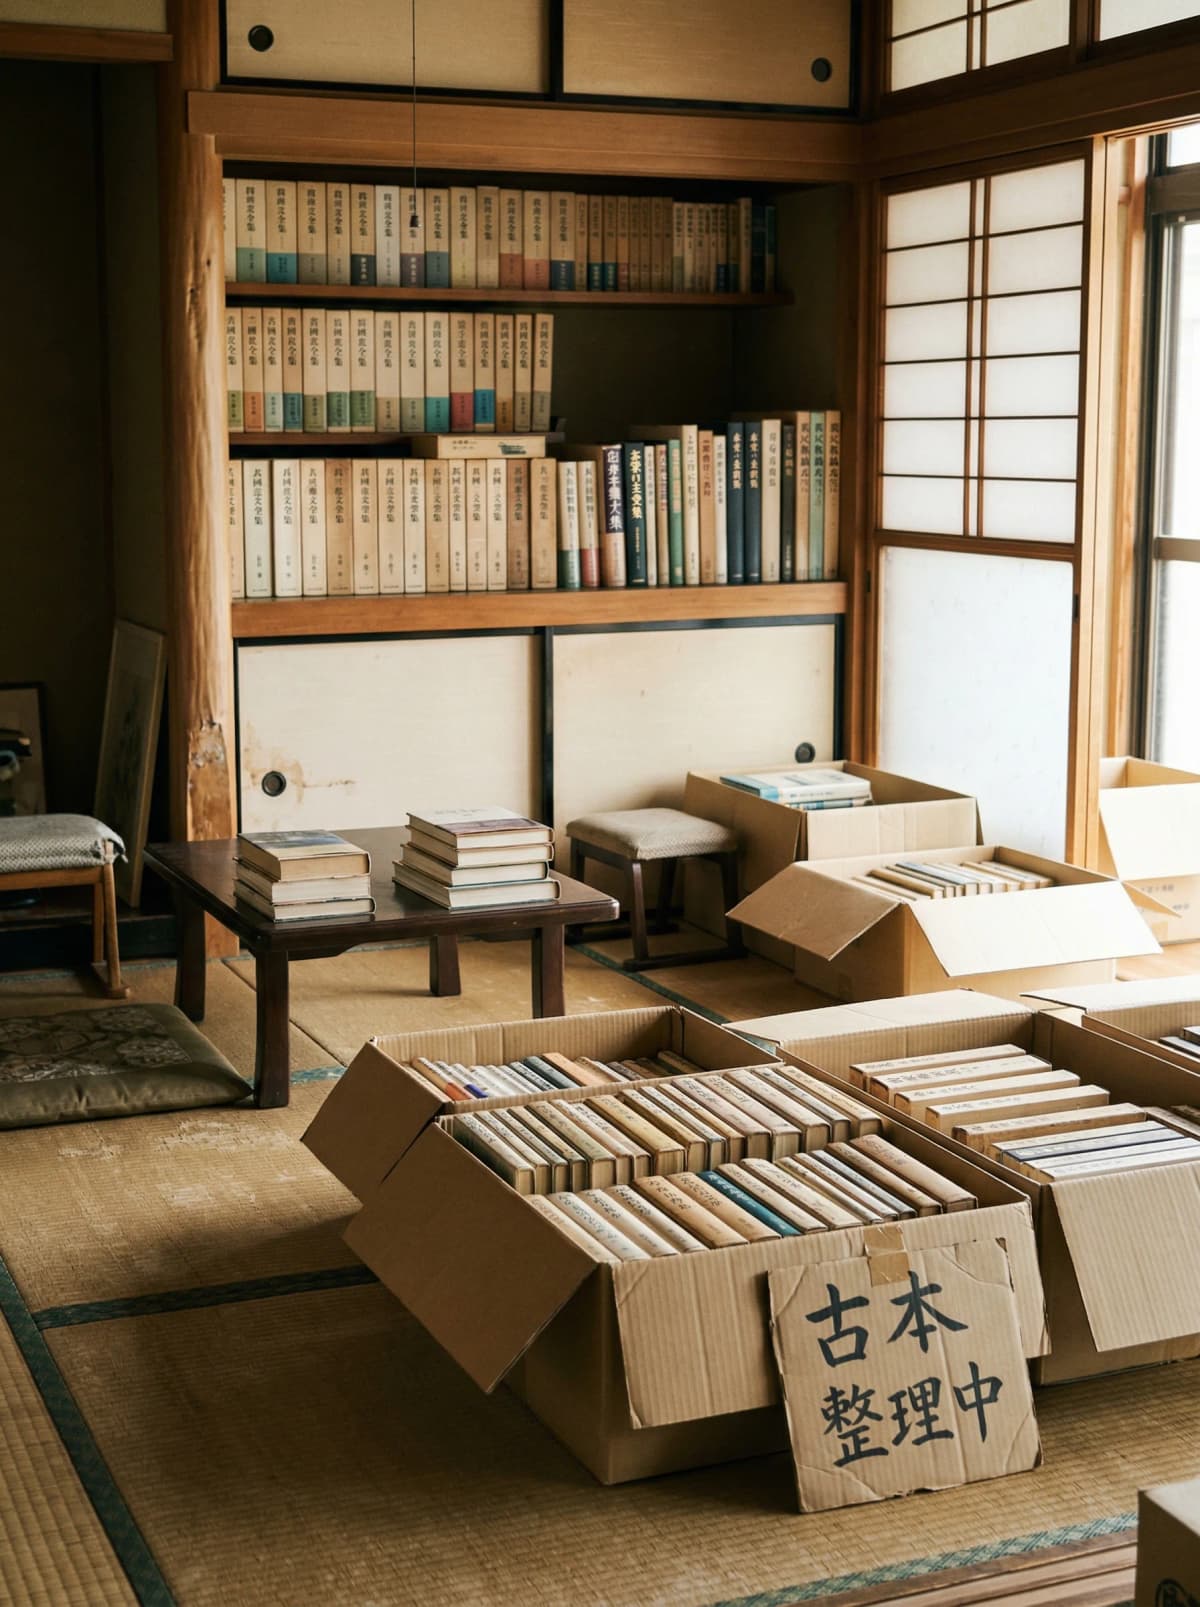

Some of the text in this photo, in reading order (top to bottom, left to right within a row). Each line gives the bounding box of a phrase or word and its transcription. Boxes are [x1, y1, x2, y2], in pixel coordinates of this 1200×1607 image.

[805, 1270, 968, 1368] 古本
[820, 1361, 1003, 1468] 整理中
